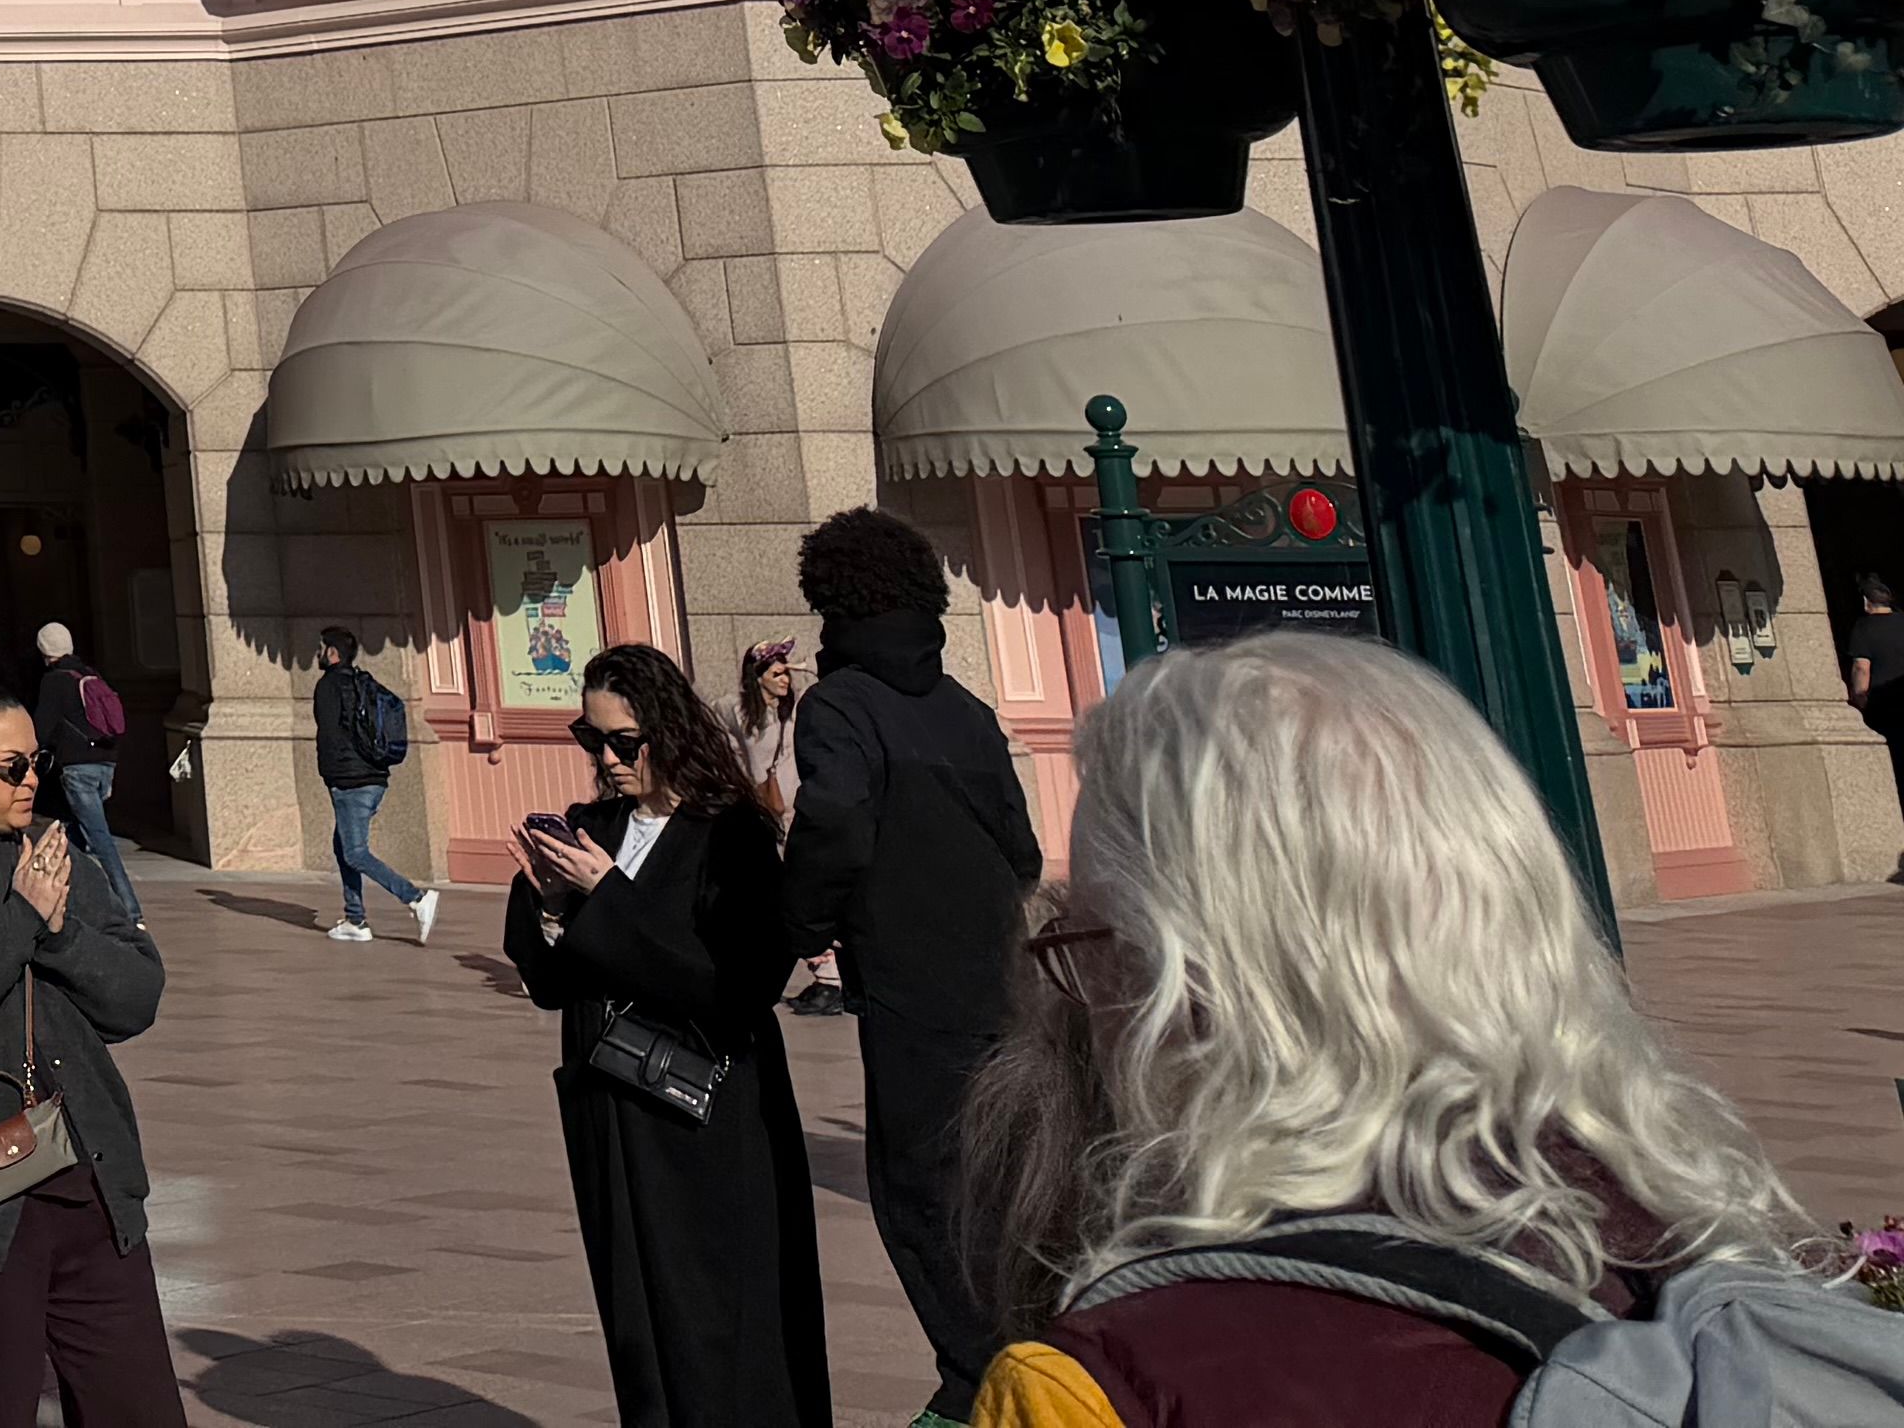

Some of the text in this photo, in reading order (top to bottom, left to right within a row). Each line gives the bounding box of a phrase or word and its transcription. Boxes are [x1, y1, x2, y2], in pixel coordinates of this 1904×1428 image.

[1193, 585, 1374, 601] LA MAGIE COMME
[1282, 610, 1303, 618] PARC
